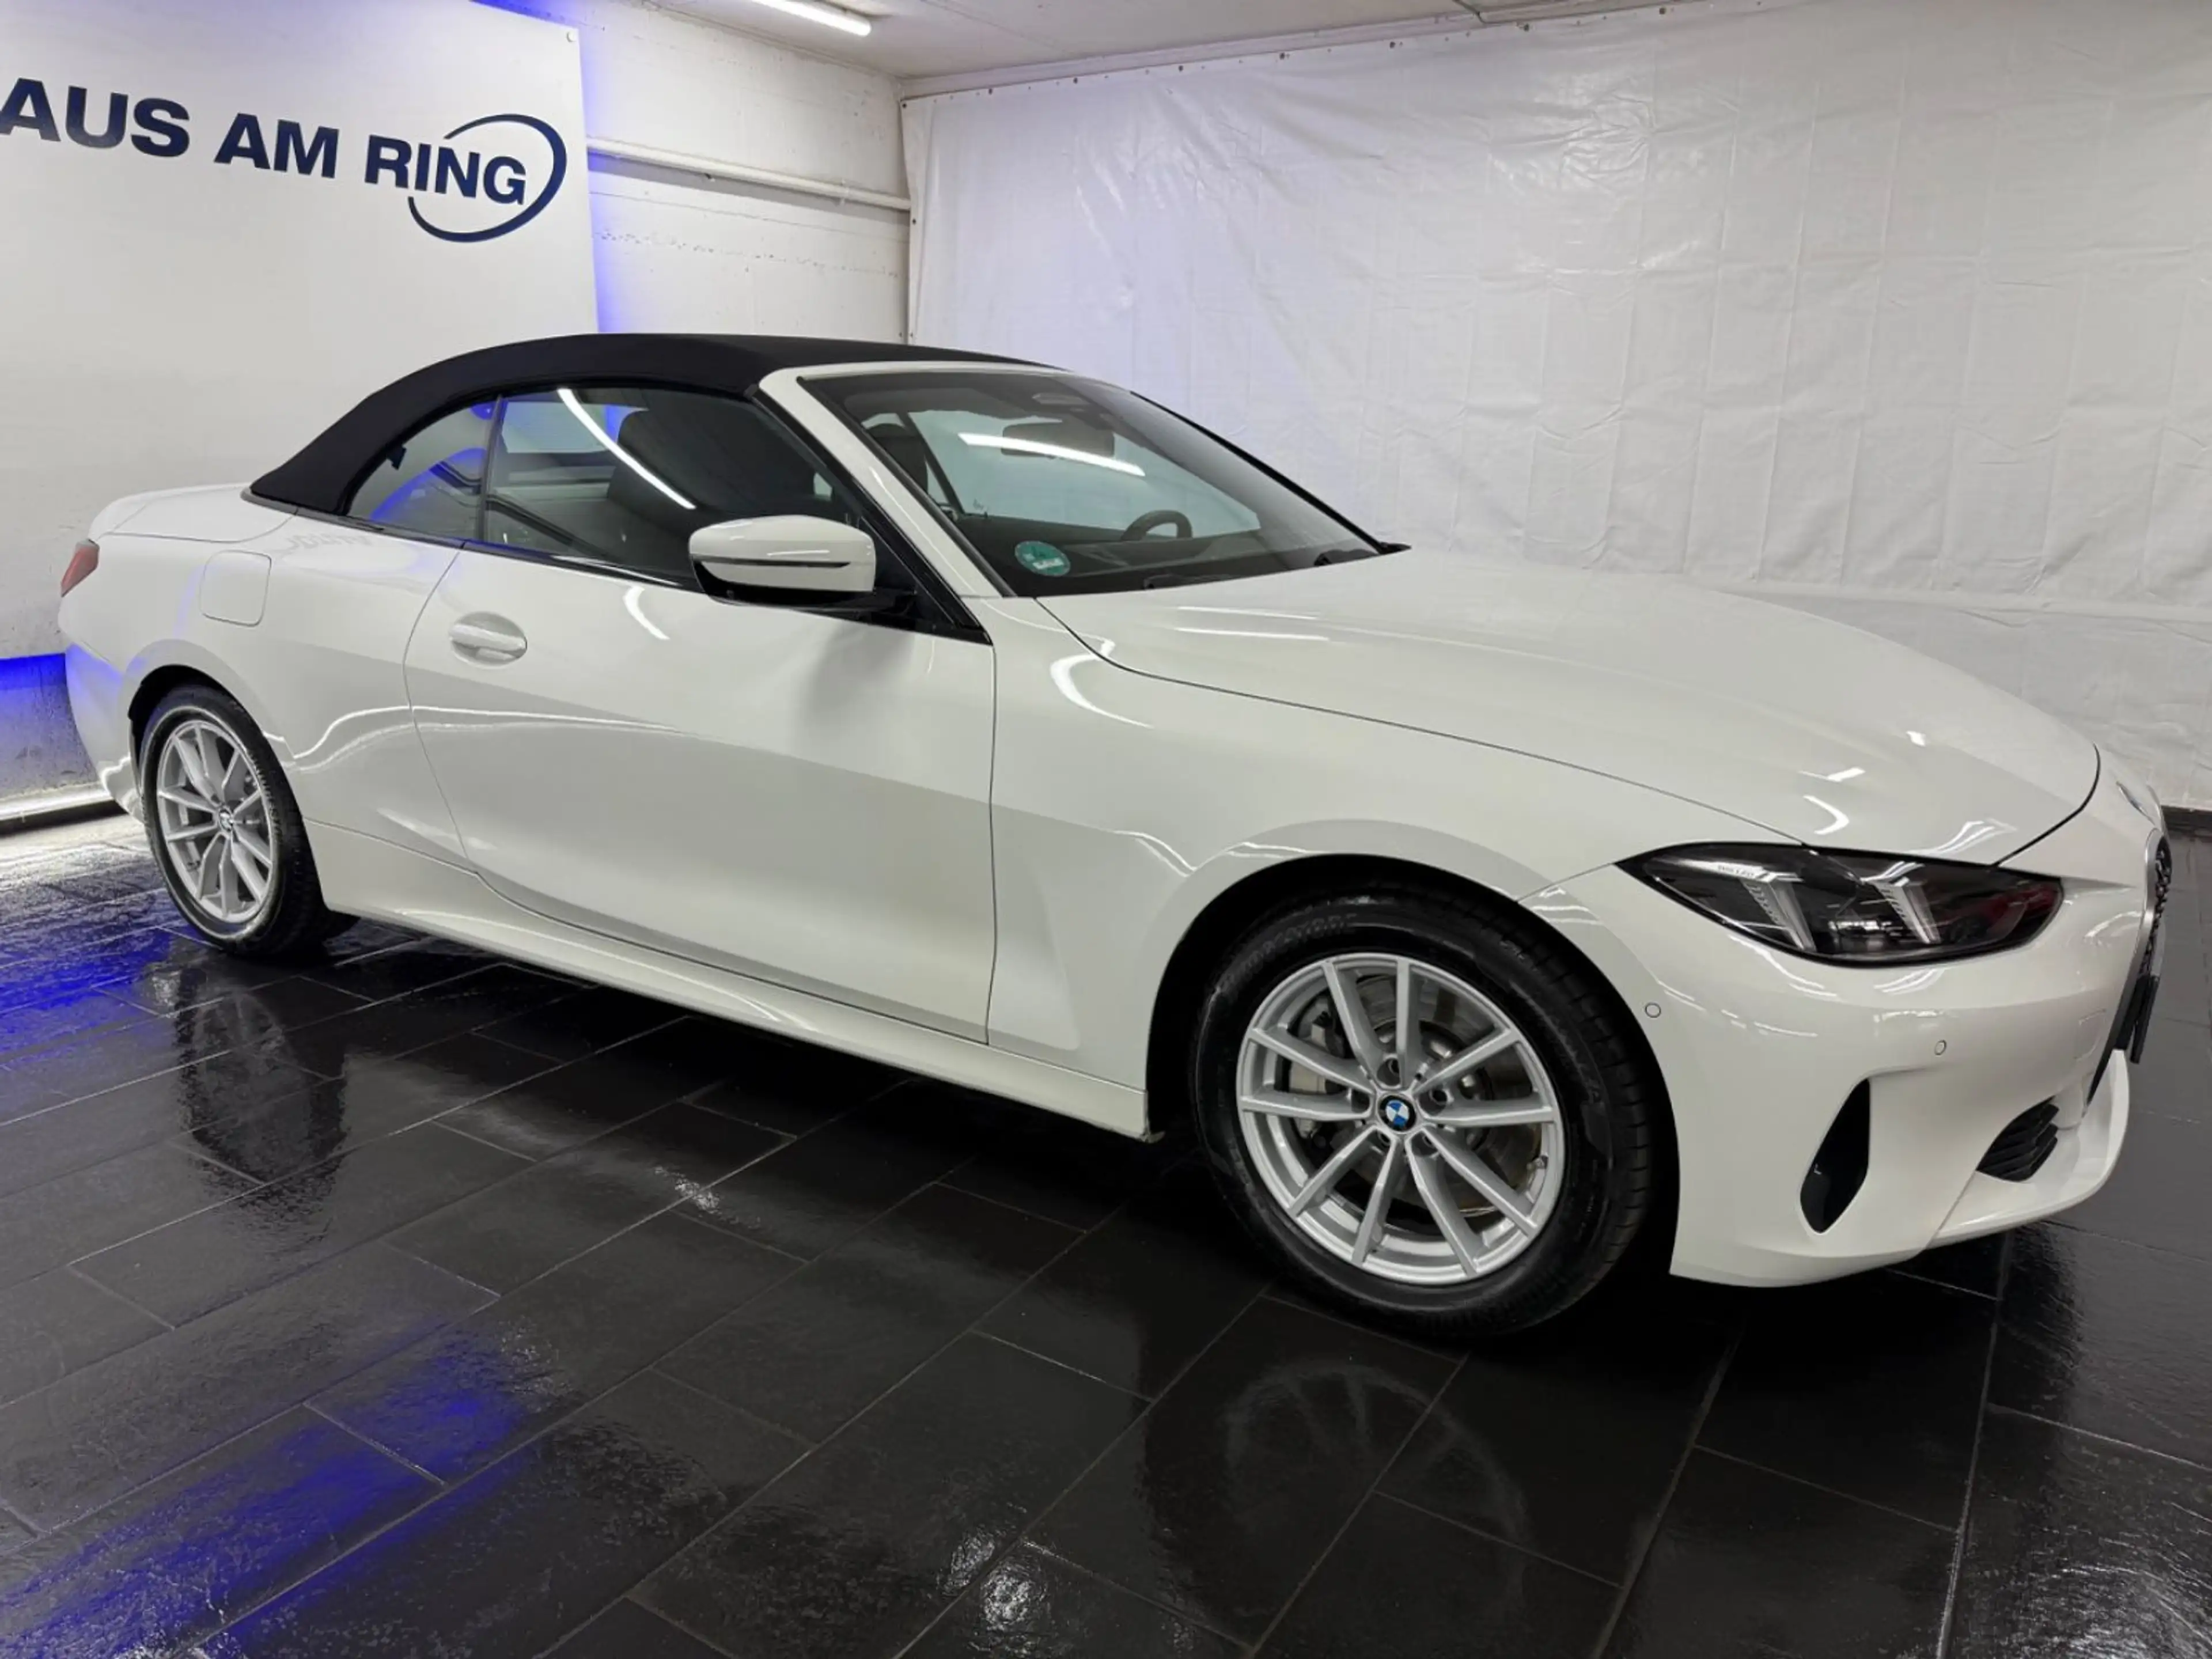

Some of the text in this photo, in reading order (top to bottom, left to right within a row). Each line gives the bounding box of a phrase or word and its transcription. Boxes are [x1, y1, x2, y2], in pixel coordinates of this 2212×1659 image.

[0, 77, 526, 205] AUS AM RING
